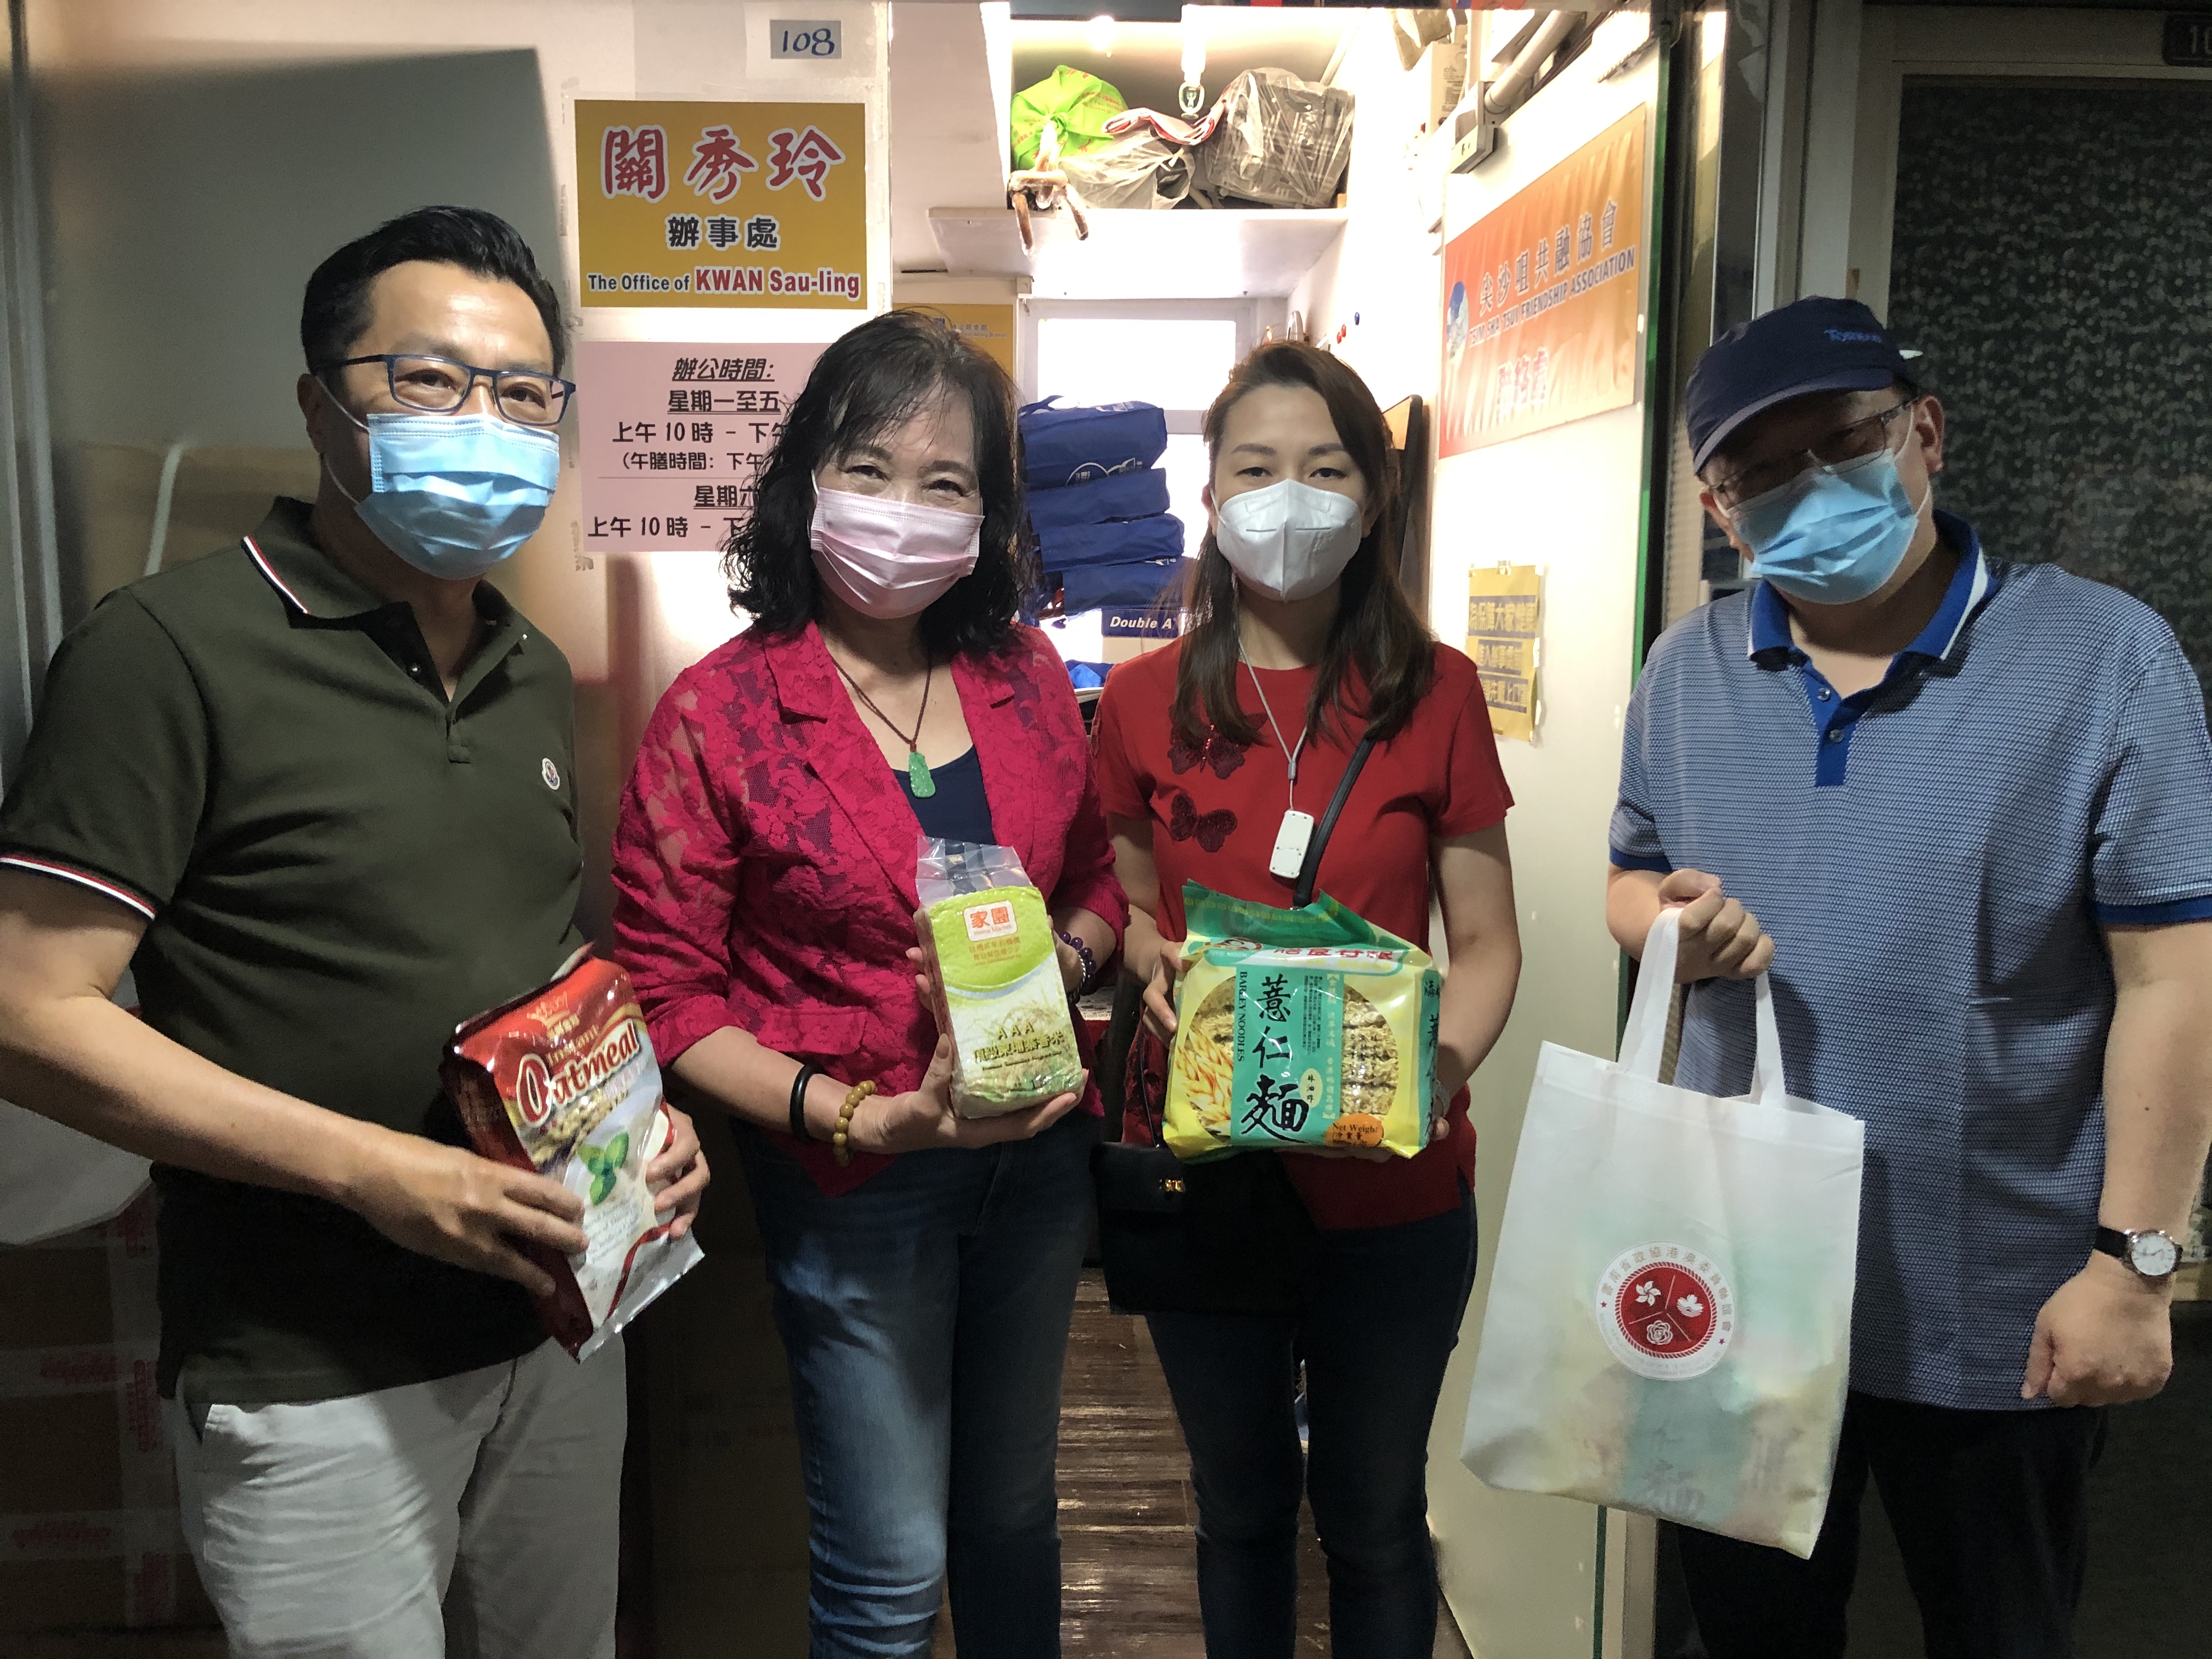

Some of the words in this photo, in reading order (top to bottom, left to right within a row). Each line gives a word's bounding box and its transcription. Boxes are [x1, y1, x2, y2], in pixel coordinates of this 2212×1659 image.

[781, 27, 835, 56] 108
[604, 127, 843, 200] 關秀玲
[667, 216, 778, 249] 辦事處
[1480, 200, 1618, 318] 尖沙咀共融協會
[588, 274, 617, 290] The
[621, 274, 670, 291] Office
[673, 274, 690, 291] of
[695, 268, 764, 292] KWAN
[769, 269, 860, 298] Sau-ling
[1521, 281, 1568, 321] FRIENDSHIP
[1570, 247, 1635, 297] ASSOCIATION
[672, 357, 775, 380] 辦公時間:
[668, 390, 780, 412] 星期一至五
[612, 421, 657, 443] 上午
[665, 422, 685, 442] 10
[692, 421, 713, 443] 時
[622, 452, 714, 471] (午膳時間:
[588, 516, 632, 538] 上午
[640, 517, 659, 536] 10
[667, 516, 689, 538] 時
[1109, 616, 1158, 629] Double
[1161, 618, 1172, 629] A
[969, 906, 1010, 929] 家園
[1238, 970, 1248, 1012] BARLEY
[1237, 1014, 1247, 1062] NOODLES
[1240, 973, 1309, 1143] 薏仁麵
[517, 1019, 640, 1127] Oatmeal
[1332, 1122, 1346, 1131] Net
[1349, 1124, 1378, 1134] Weight
